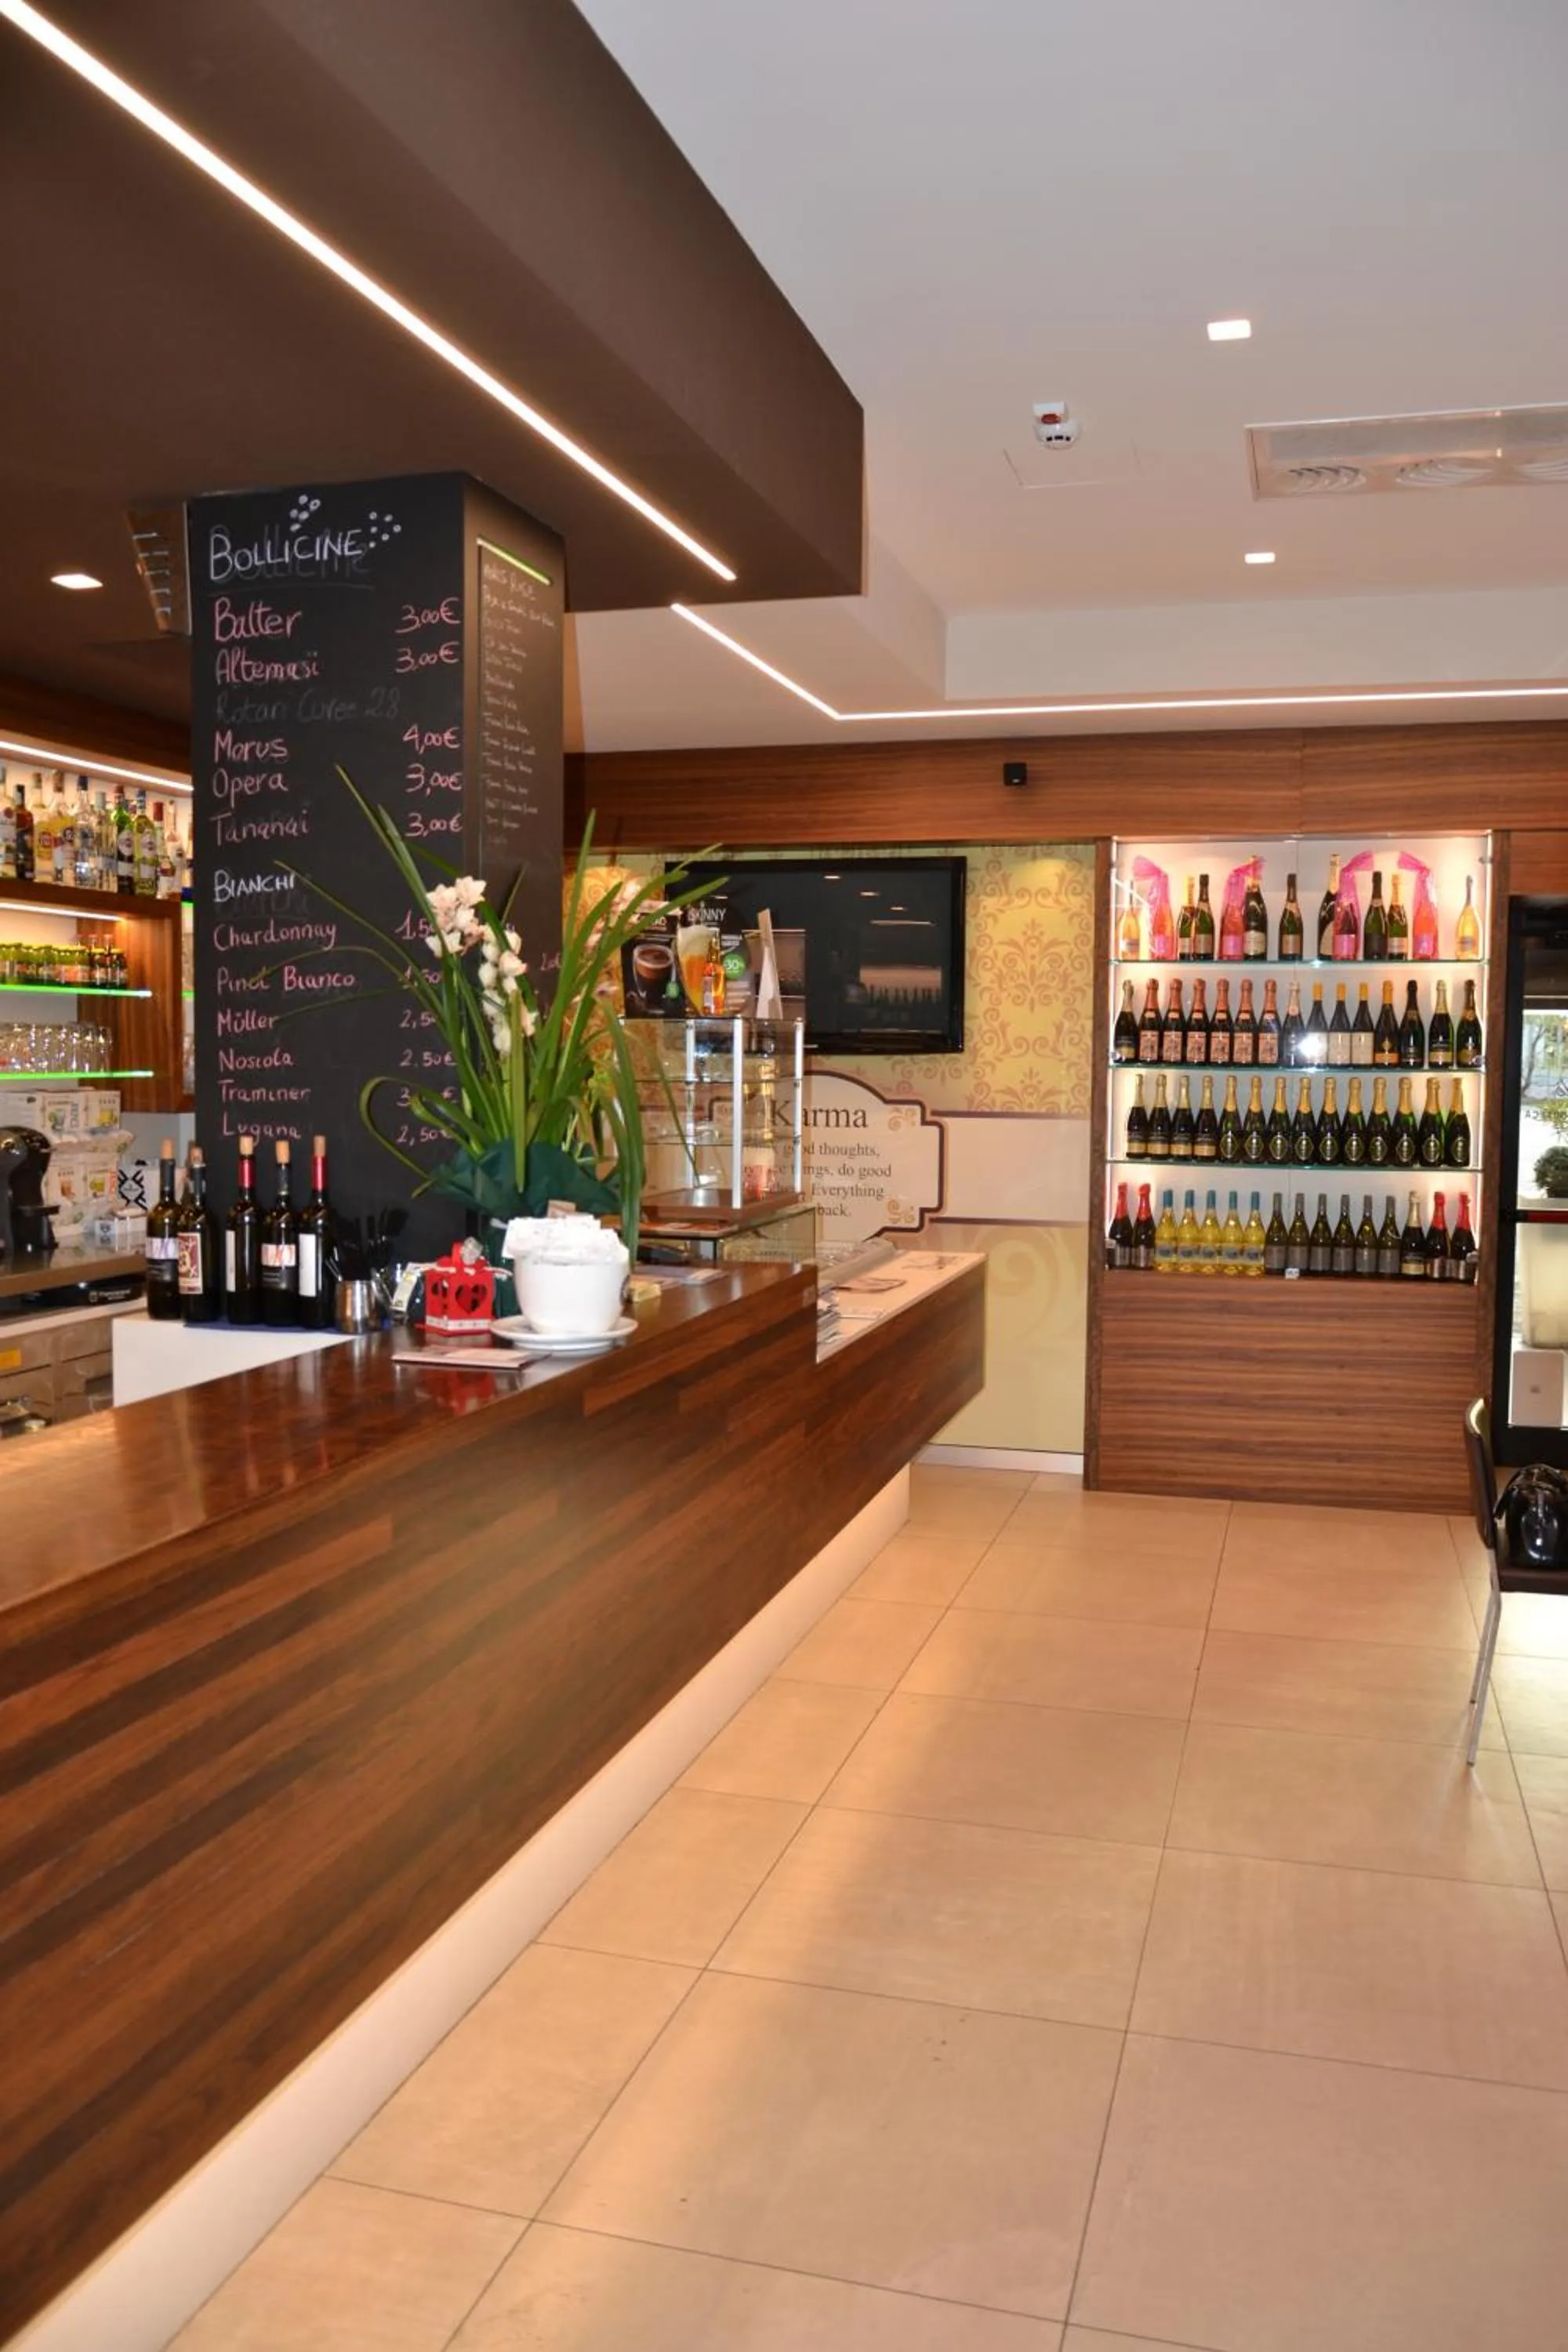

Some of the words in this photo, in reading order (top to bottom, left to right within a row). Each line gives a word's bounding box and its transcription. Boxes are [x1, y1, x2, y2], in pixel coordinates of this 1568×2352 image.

[209, 528, 363, 581] BOLLICINE
[214, 596, 303, 642] Balter
[394, 641, 459, 673] 3,00€
[213, 728, 289, 763] Morus
[401, 722, 460, 755] 4,00€
[212, 768, 289, 809] Opera
[405, 762, 463, 797] 3,00€
[404, 811, 463, 839] 3,00€
[213, 916, 337, 951] Chardonnay
[283, 964, 356, 992] Bianco
[216, 1007, 280, 1038] Müller
[217, 1079, 312, 1103] Traminer
[223, 1111, 302, 1147] Lugana
[770, 1099, 869, 1129] Karma
[818, 1142, 880, 1160] thoughts,
[837, 1162, 855, 1178] do
[858, 1163, 892, 1181] good
[811, 1181, 885, 1201] Everything
